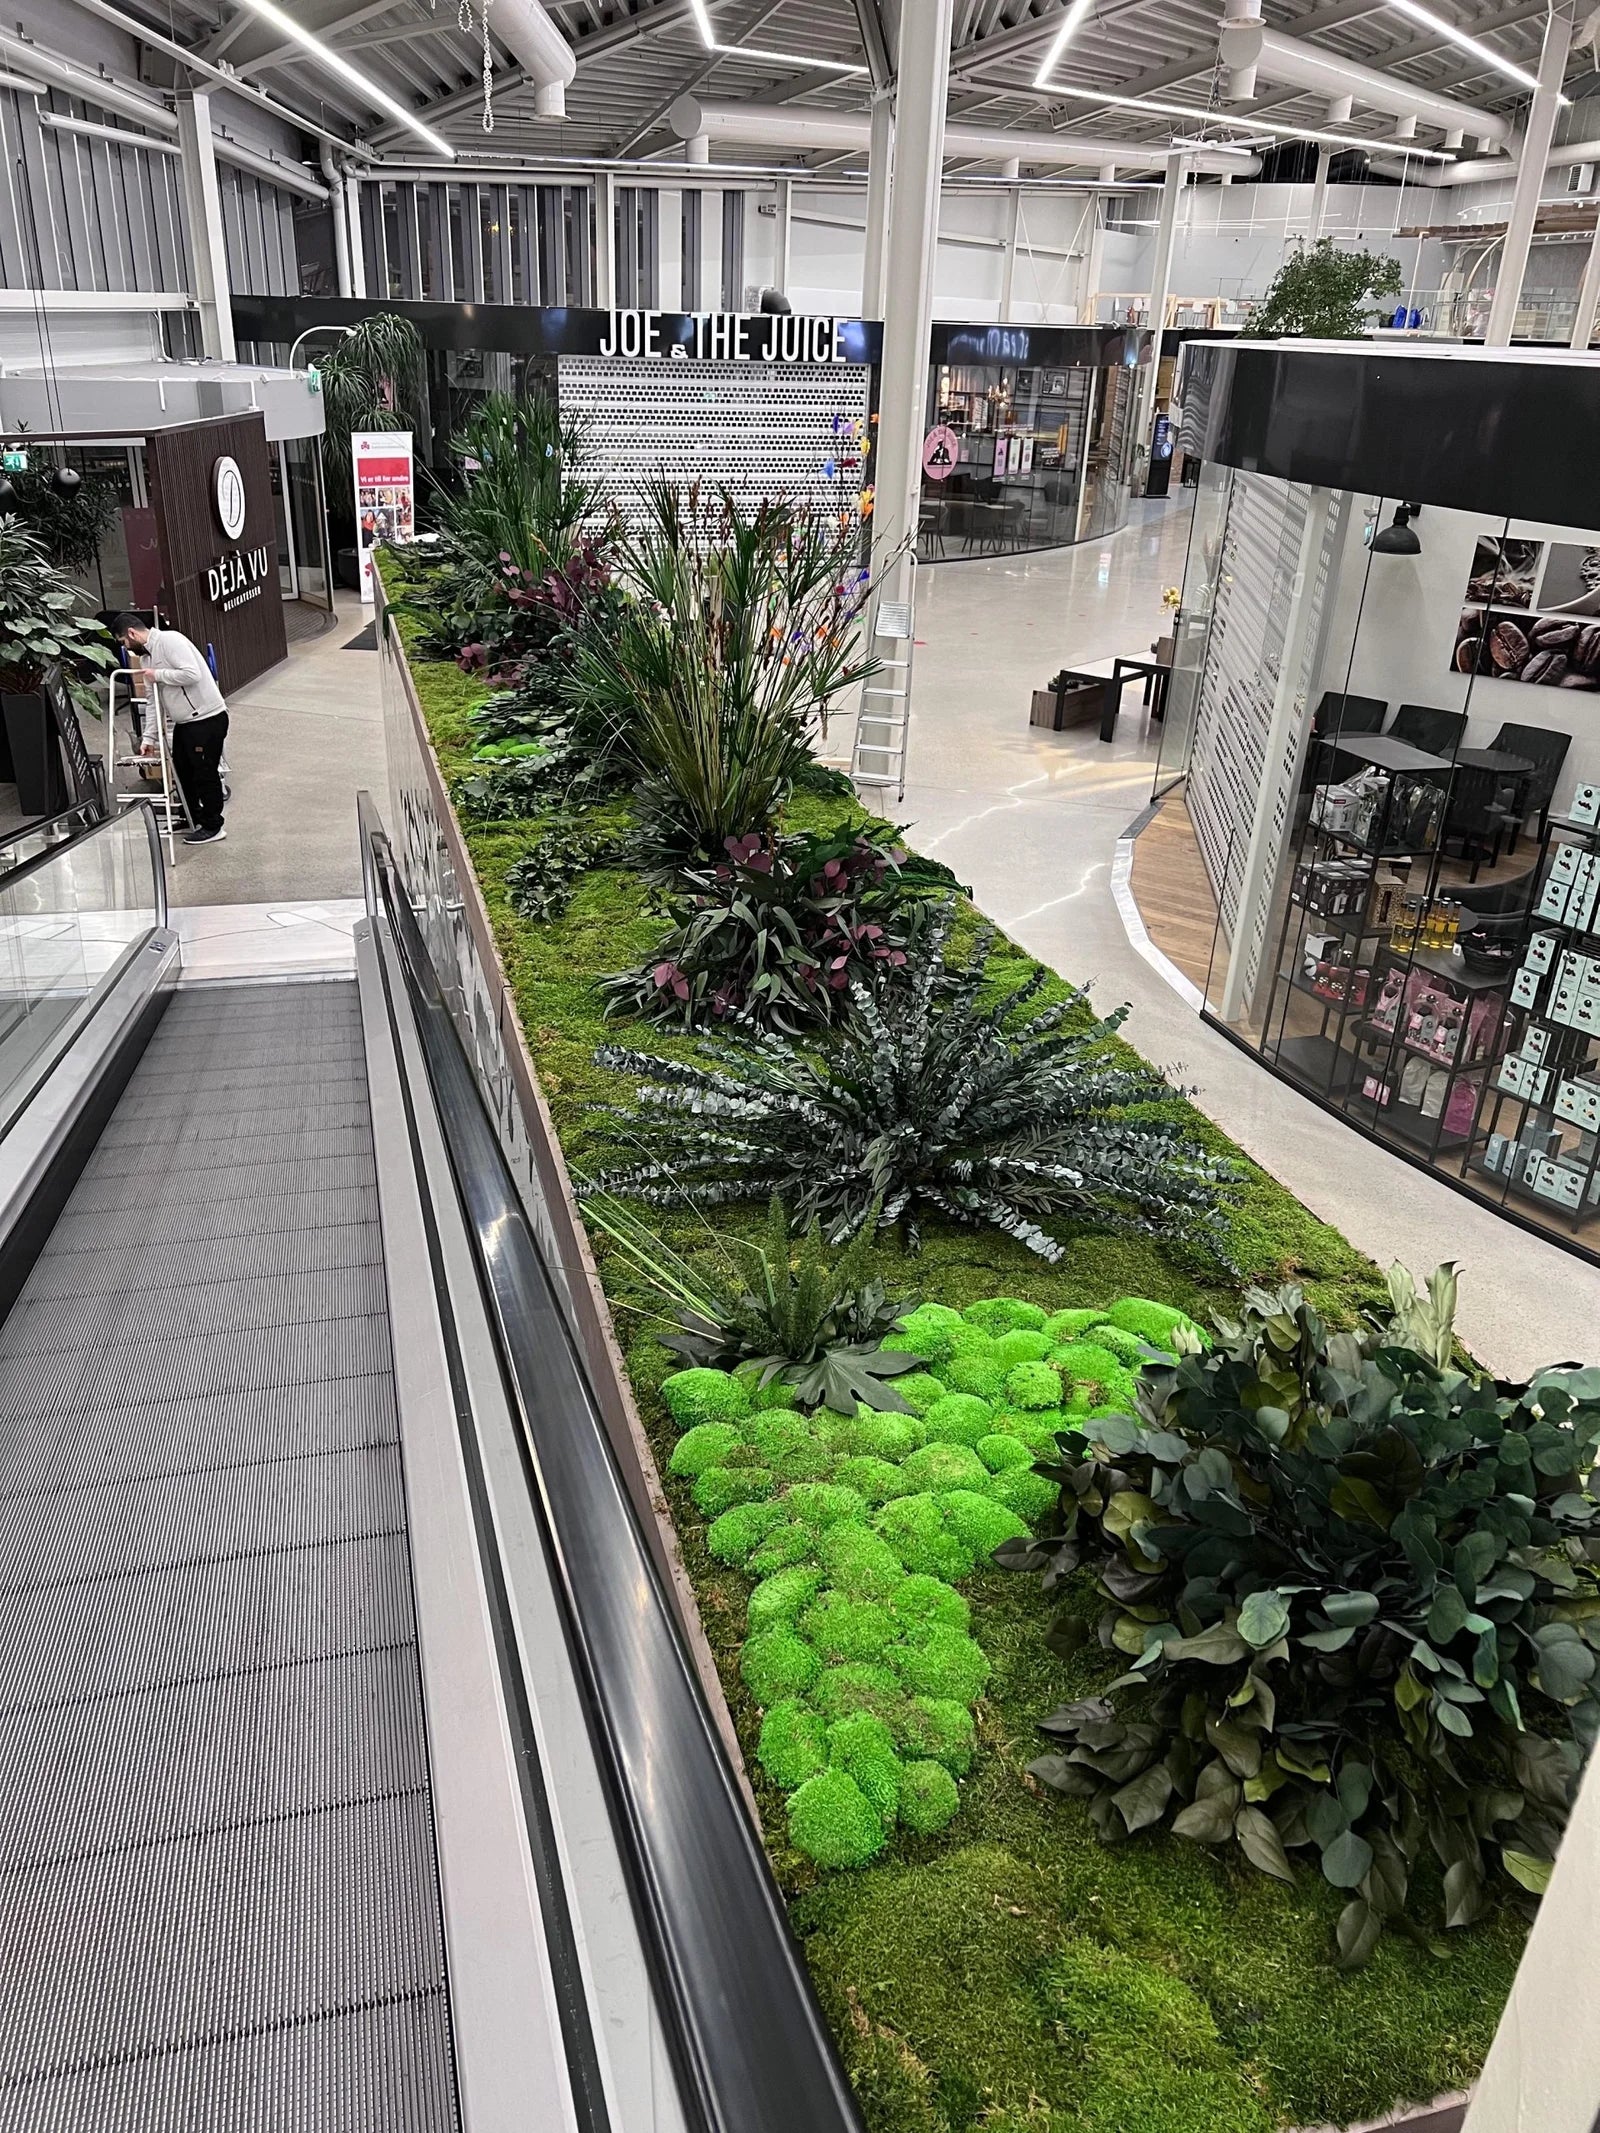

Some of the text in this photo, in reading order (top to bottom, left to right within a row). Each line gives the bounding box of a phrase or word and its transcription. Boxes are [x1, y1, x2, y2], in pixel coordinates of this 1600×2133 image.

[600, 310, 847, 363] JOE & THE JUICE
[208, 546, 268, 602] DÉJÀ VU
